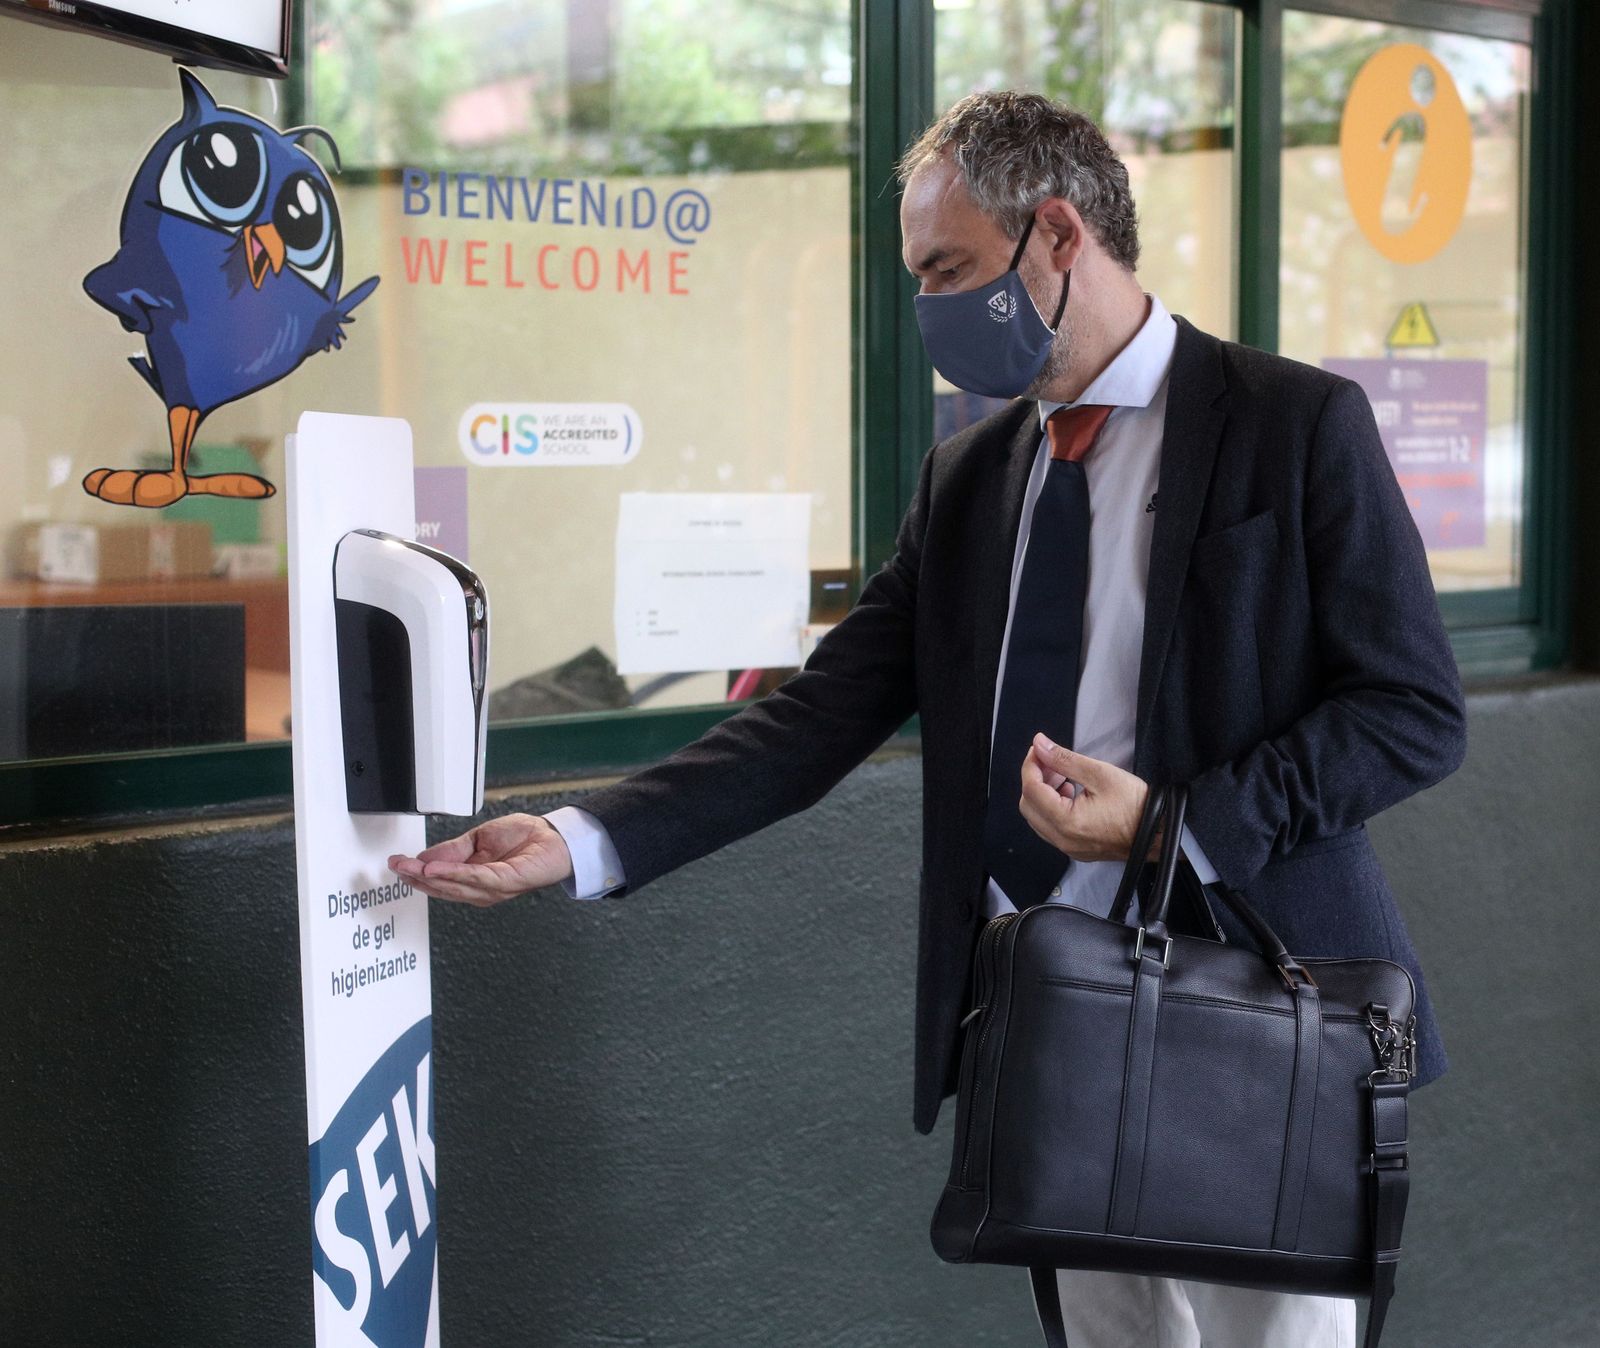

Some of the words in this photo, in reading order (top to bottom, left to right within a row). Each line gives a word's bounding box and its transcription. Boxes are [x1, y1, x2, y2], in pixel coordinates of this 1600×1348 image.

[48, 0, 76, 14] SAMSUNG
[401, 236, 690, 295] WELCOME
[543, 415, 560, 426] WE
[564, 415, 586, 426] ARE
[590, 415, 607, 426] AN
[470, 414, 539, 455] CIS
[543, 429, 618, 440] ACCREDITED
[543, 443, 591, 455] SCHOOL
[352, 925, 370, 950] de
[374, 915, 395, 950] gel
[331, 950, 417, 997] higienizante
